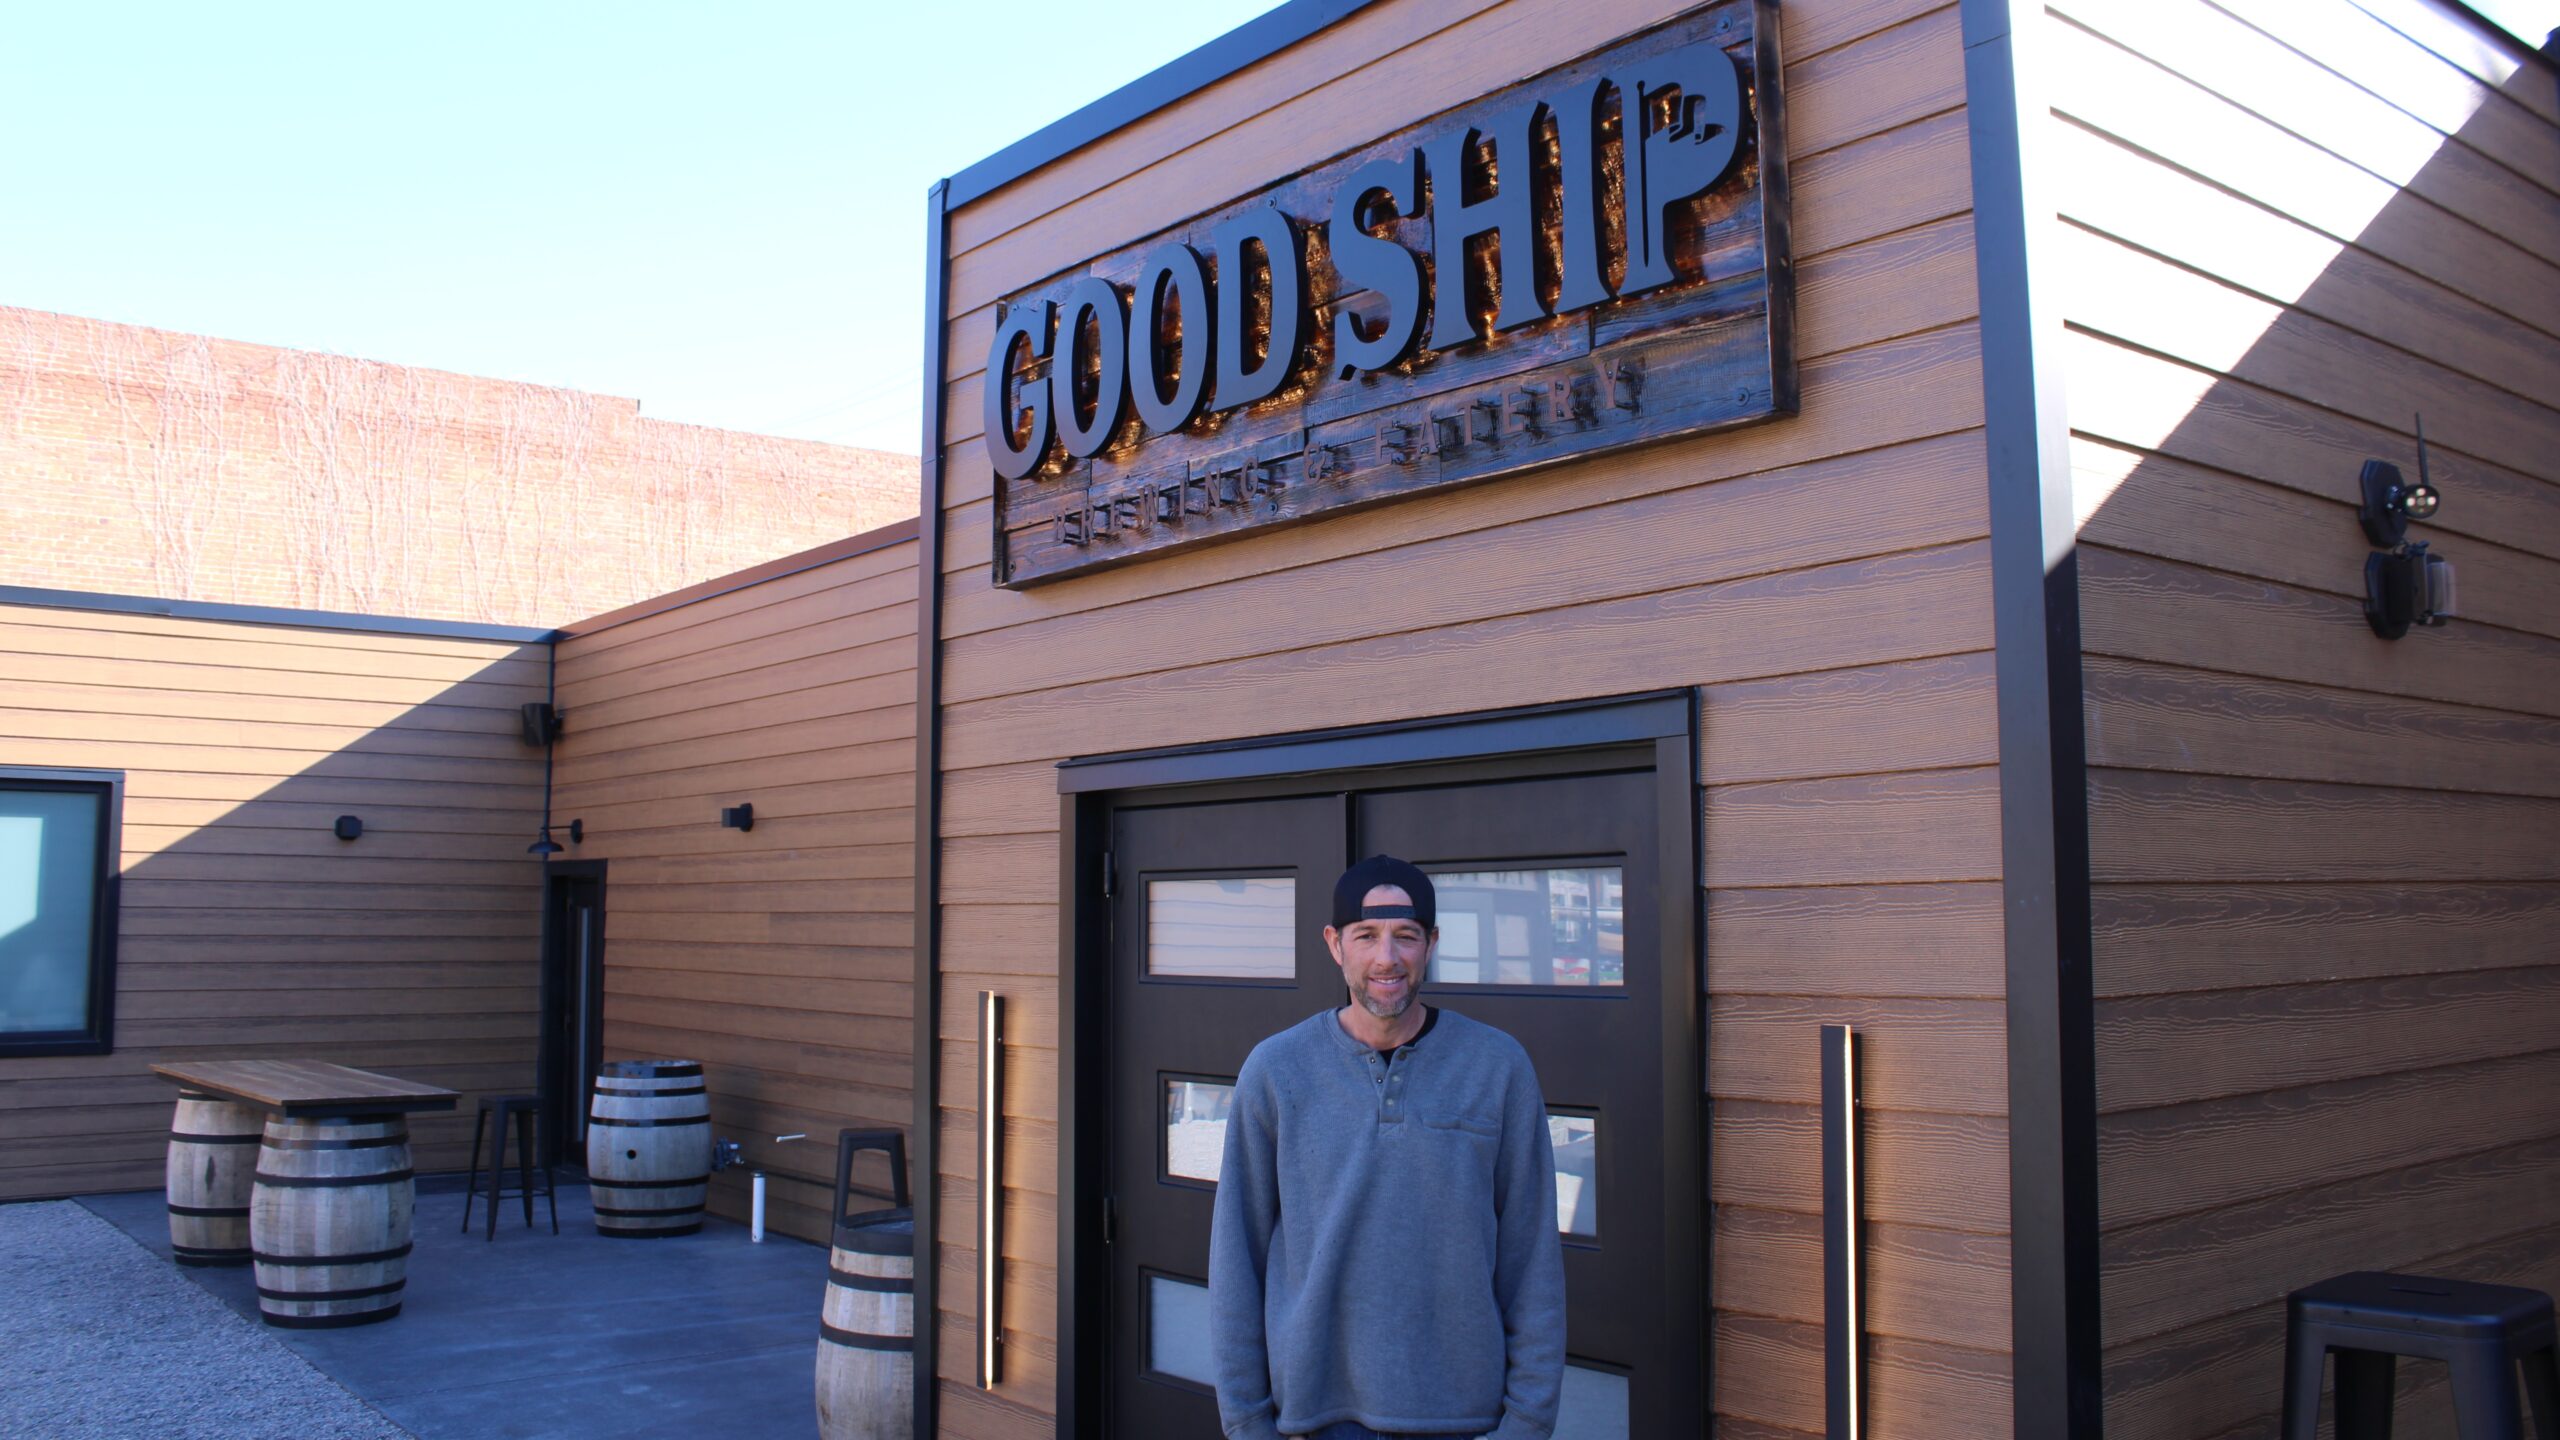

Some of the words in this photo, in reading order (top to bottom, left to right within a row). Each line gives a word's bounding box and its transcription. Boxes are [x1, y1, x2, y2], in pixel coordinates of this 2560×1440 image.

[983, 206, 1303, 479] GOOD
[1329, 43, 1743, 377] SHIP
[1053, 457, 1259, 545] BREWING
[1303, 441, 1328, 484] &
[1375, 357, 1621, 466] EATERY
